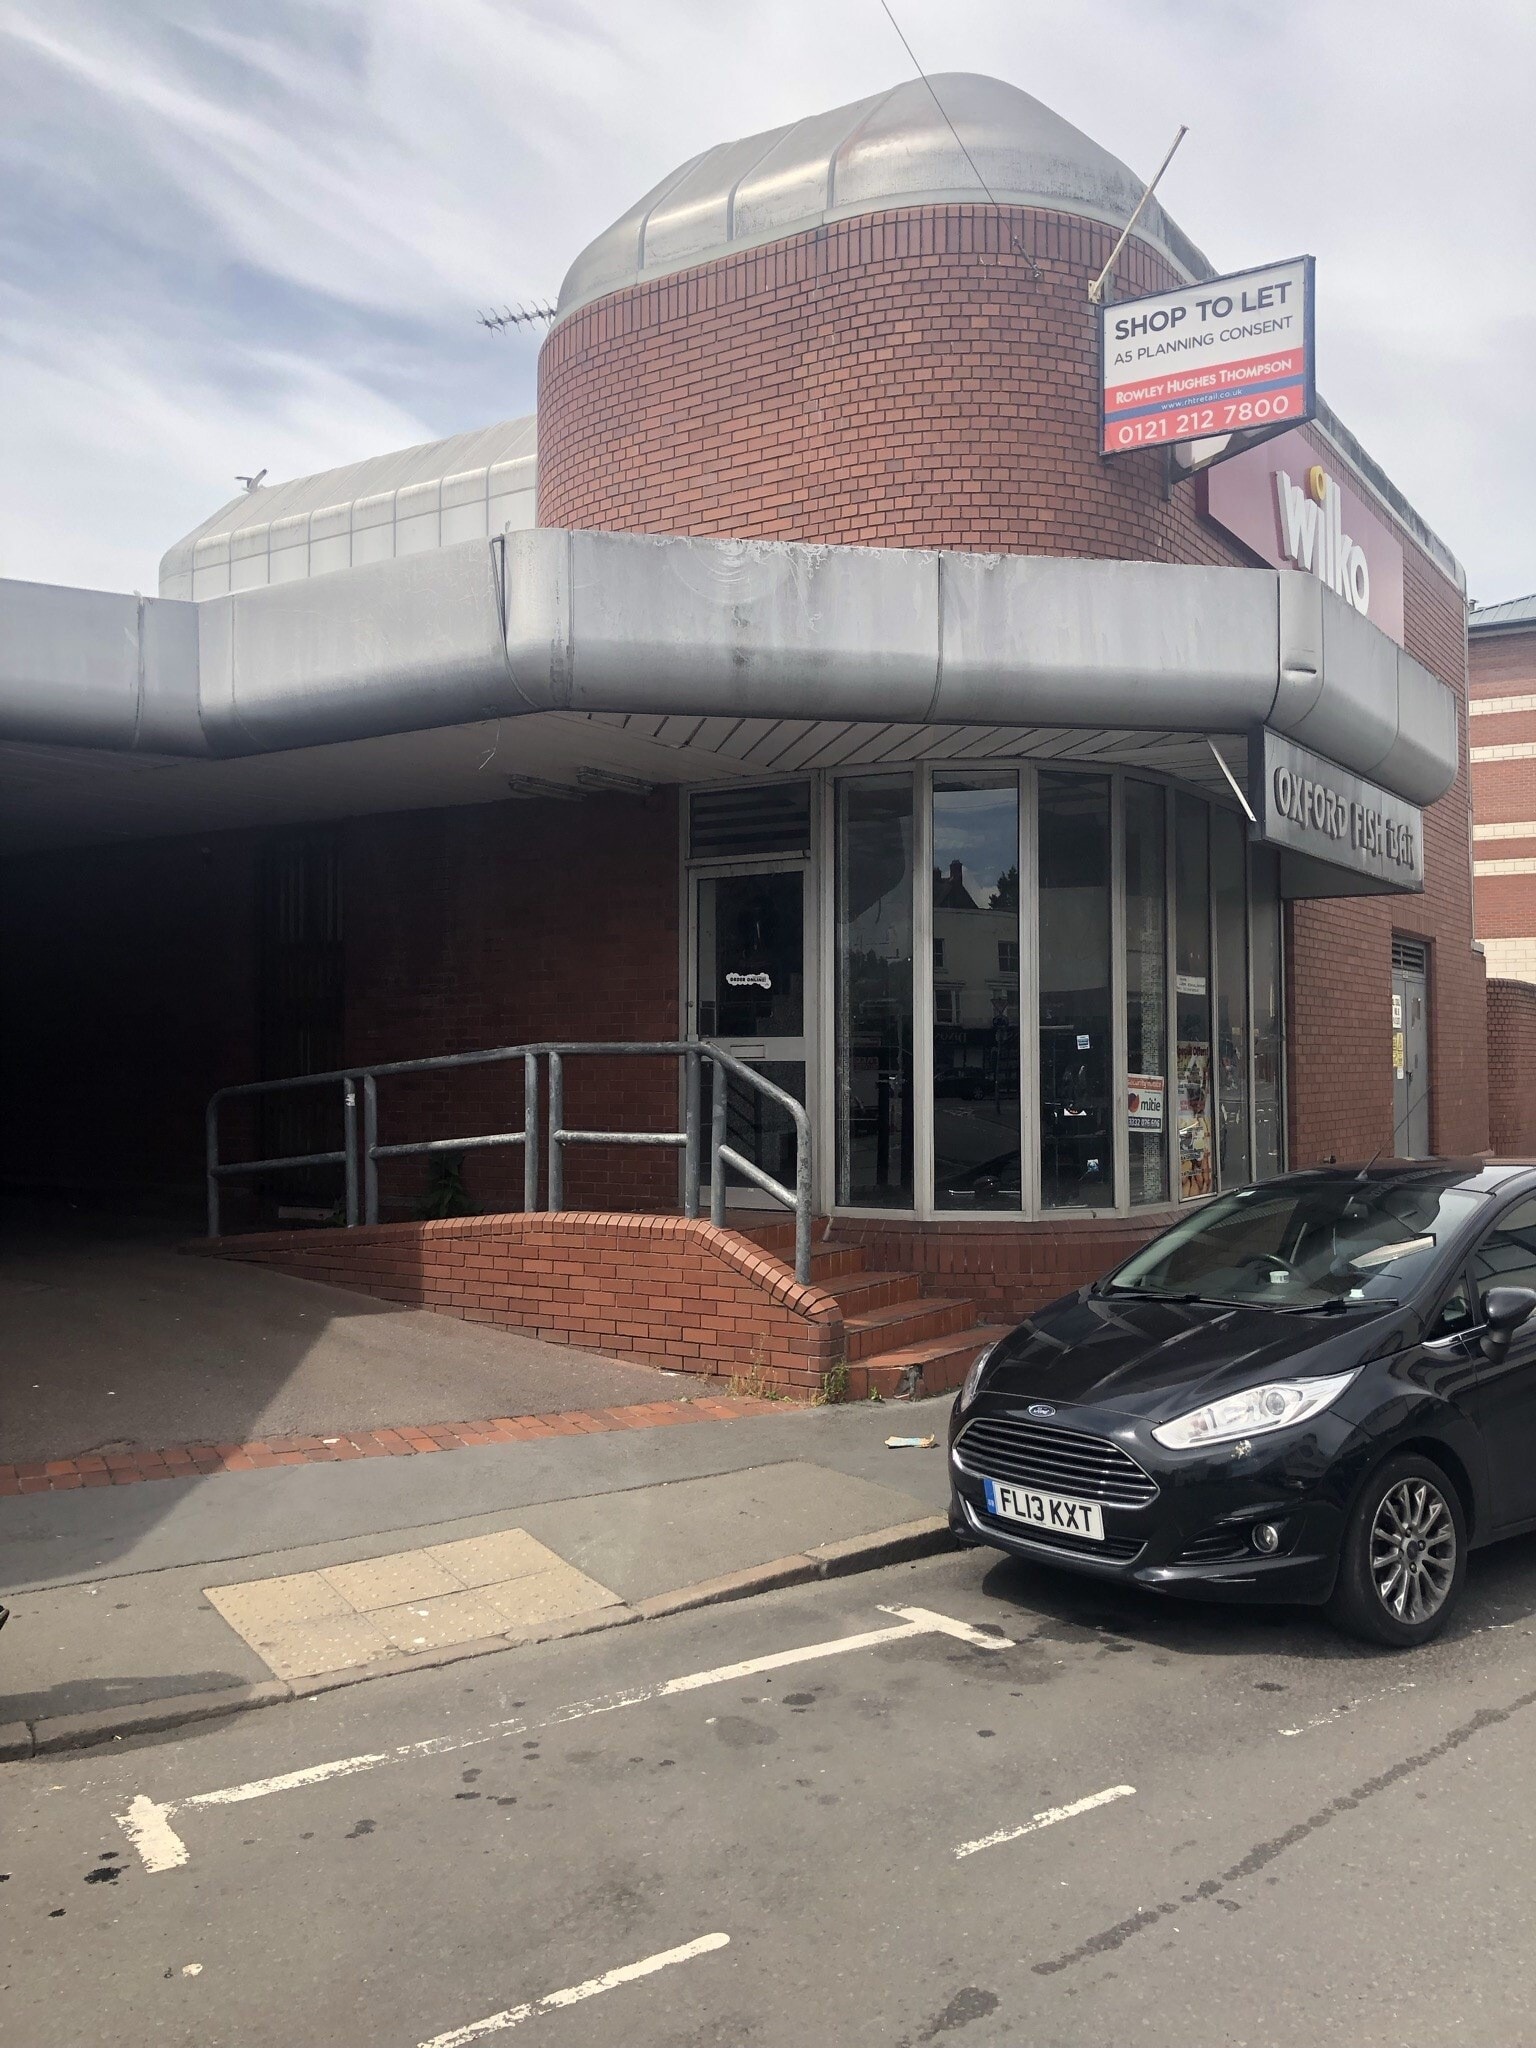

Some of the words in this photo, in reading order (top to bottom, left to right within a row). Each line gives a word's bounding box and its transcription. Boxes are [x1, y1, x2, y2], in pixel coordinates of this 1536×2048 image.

[1115, 306, 1187, 340] SHOP
[1195, 296, 1233, 321] TO
[1241, 281, 1292, 313] LET
[1114, 351, 1133, 366] A5
[1137, 333, 1214, 360] PLANNING
[1219, 316, 1293, 342] CONSENT
[1116, 384, 1164, 405] ROWLEY
[1167, 373, 1217, 394] HUGHES
[1219, 359, 1292, 383] THOMPSON
[1161, 389, 1243, 411] www.rhtretail.co.uk
[1118, 418, 1167, 445] 0121
[1175, 409, 1214, 434] 212
[1223, 395, 1289, 424] 7800
[1275, 465, 1370, 617] wilko
[1274, 766, 1349, 841] OXFORD
[1351, 802, 1384, 857] FISH
[1386, 819, 1415, 870] BAR
[1141, 1097, 1161, 1111] mitie
[1000, 1487, 1045, 1521] FL13
[1049, 1499, 1092, 1532] KXT
